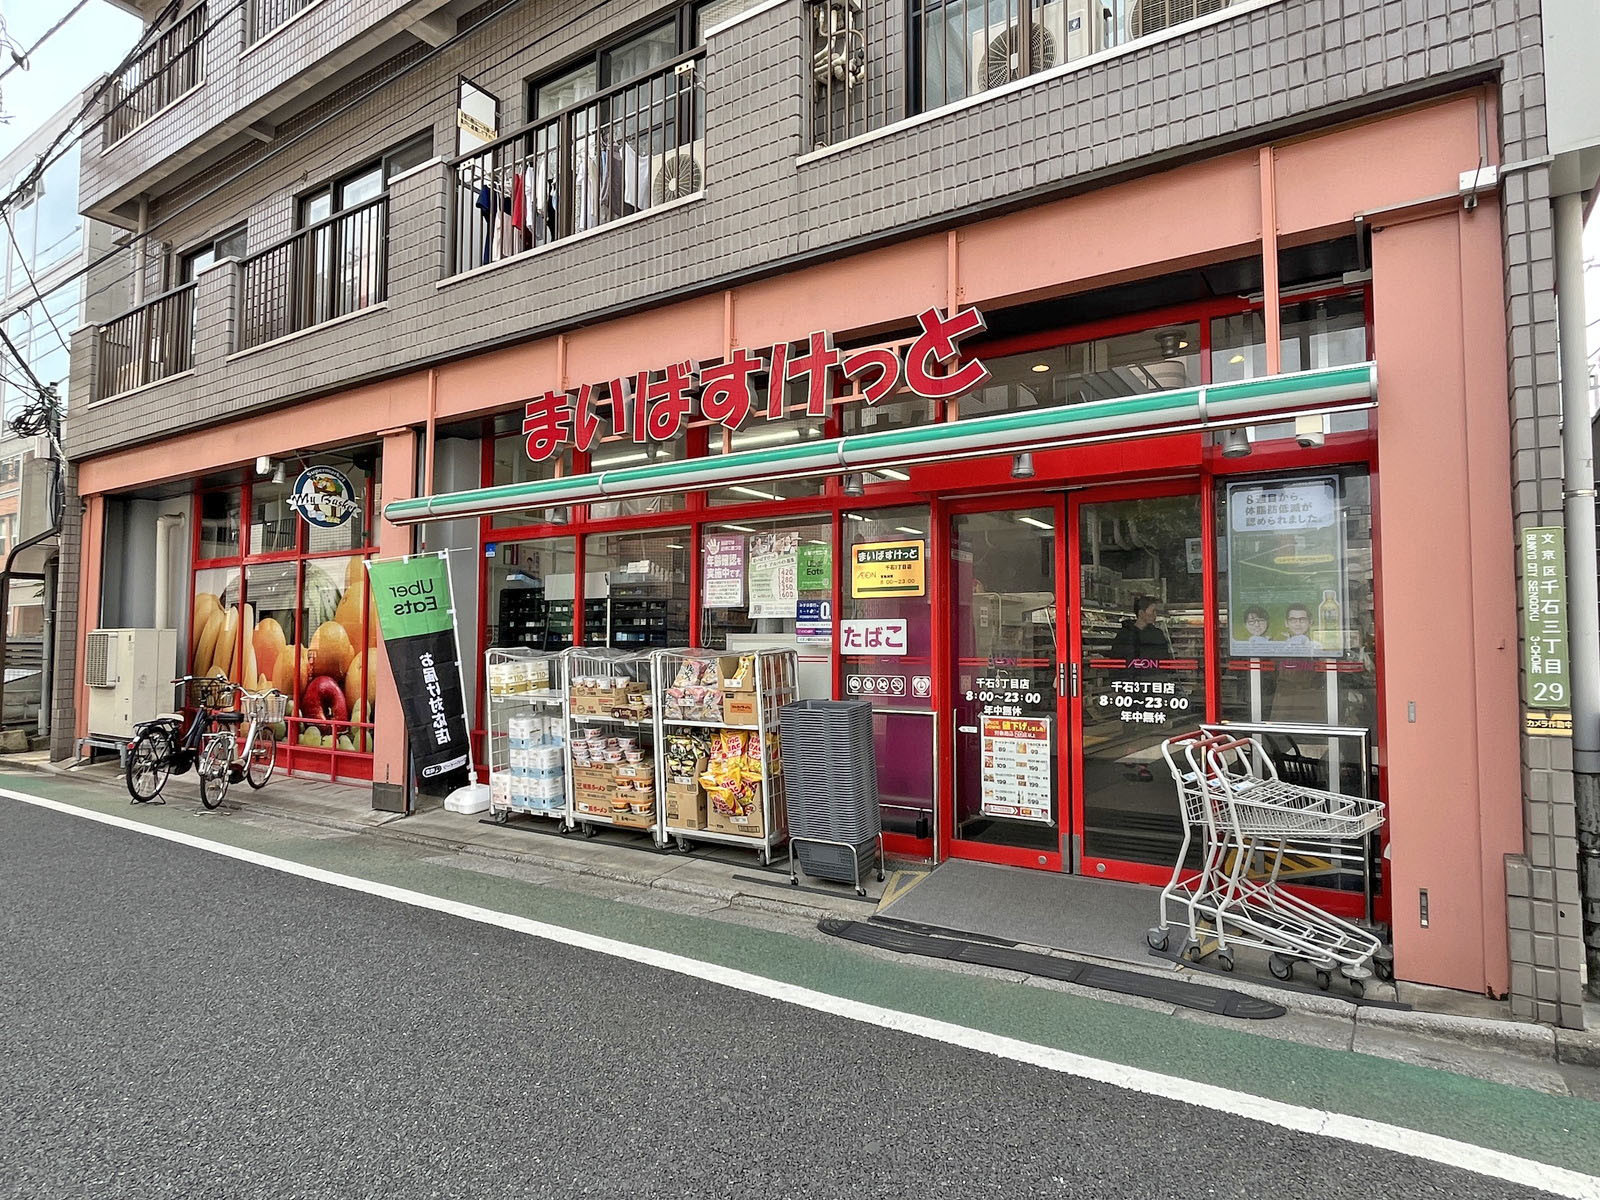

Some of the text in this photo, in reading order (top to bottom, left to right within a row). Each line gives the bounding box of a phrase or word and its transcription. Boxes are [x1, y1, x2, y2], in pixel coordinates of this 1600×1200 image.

[522, 304, 991, 462] まいばすけっと
[306, 468, 346, 483] Supermarket
[291, 493, 316, 506] My
[1526, 534, 1538, 560] BUNKYO
[858, 548, 918, 562] まいばすけっと
[1527, 562, 1539, 577] CITY
[844, 626, 903, 648] たばこ
[1530, 635, 1542, 674] 3-CHOME
[976, 678, 1030, 690] 千石3丁目店
[1111, 681, 1176, 695] 千石3丁目店
[1533, 682, 1564, 702] 29
[983, 705, 1023, 717] 年中無休
[1120, 710, 1167, 724] 年中無休
